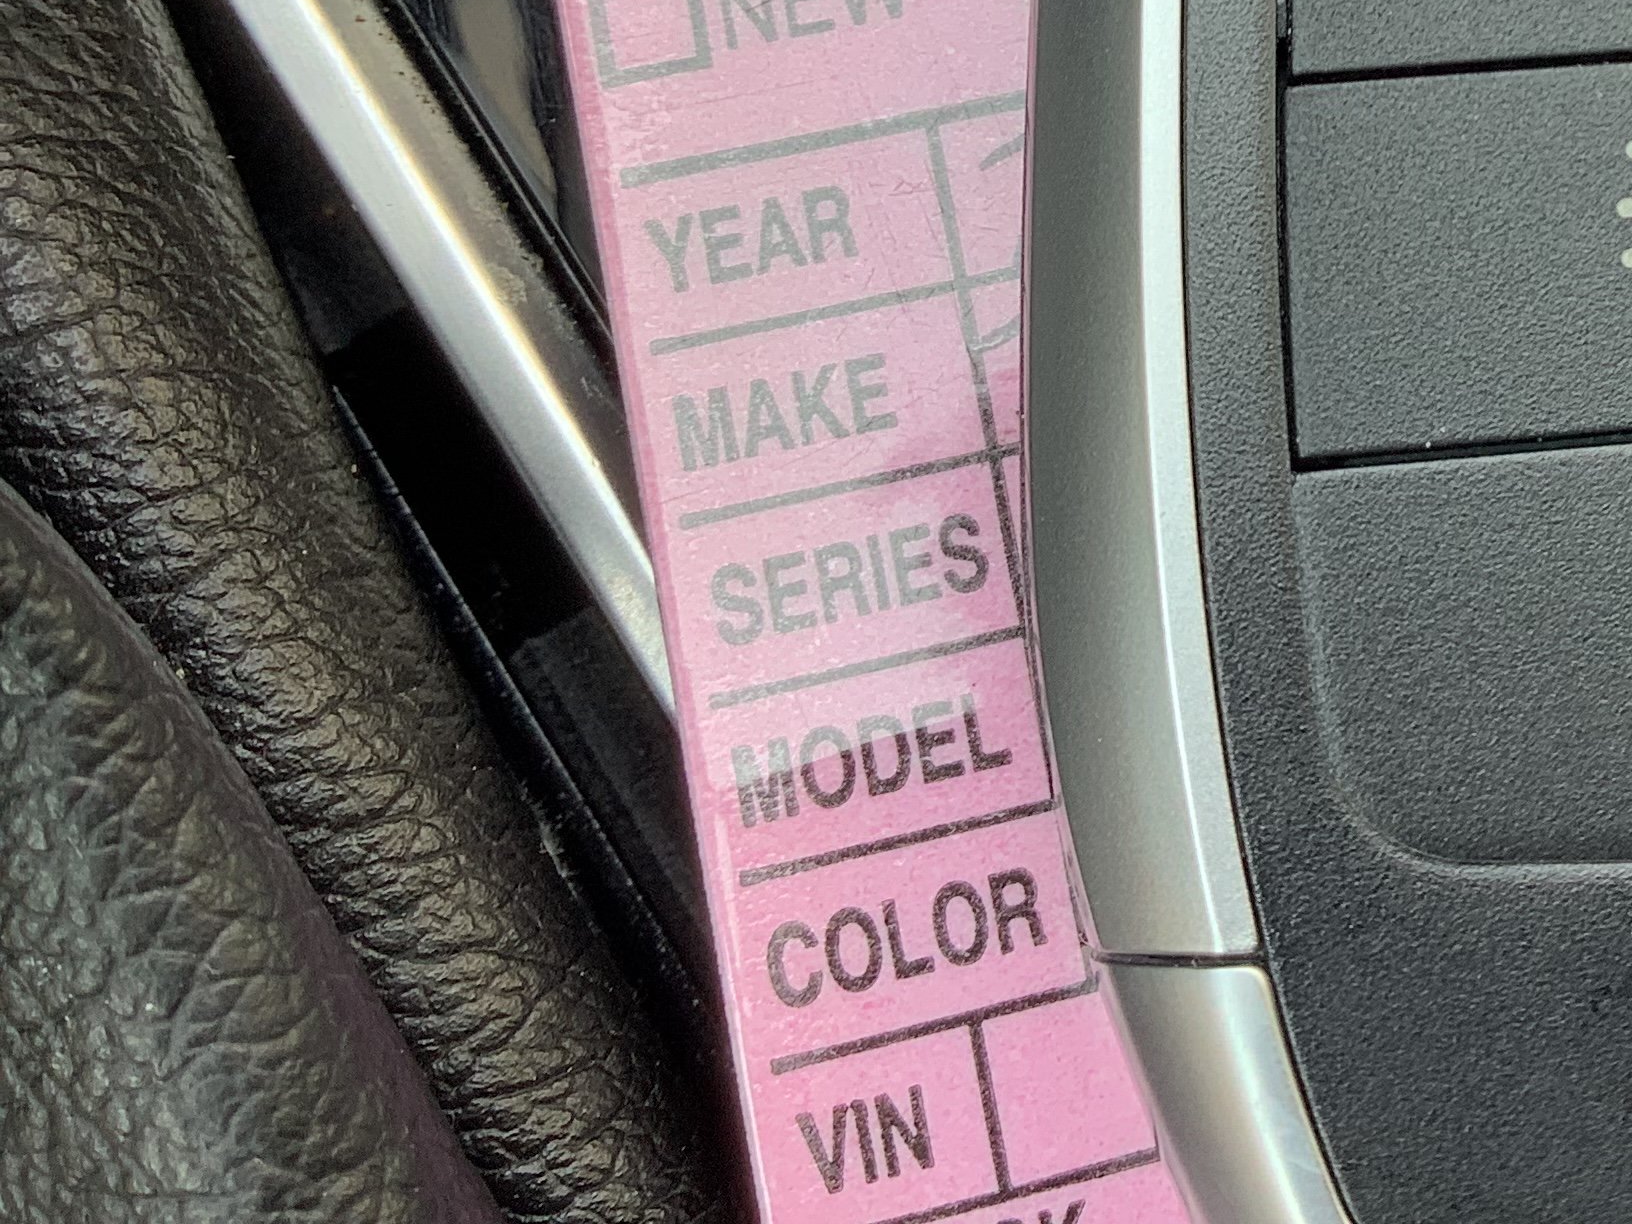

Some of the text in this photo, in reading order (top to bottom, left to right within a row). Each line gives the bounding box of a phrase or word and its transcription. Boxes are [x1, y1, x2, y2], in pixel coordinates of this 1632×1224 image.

[643, 185, 859, 293] YEAR
[671, 352, 898, 472] MAKE
[710, 513, 989, 646] SERIES
[731, 692, 1013, 828] MODEL
[767, 867, 1047, 1008] COLOR
[795, 1084, 935, 1194] VIN
